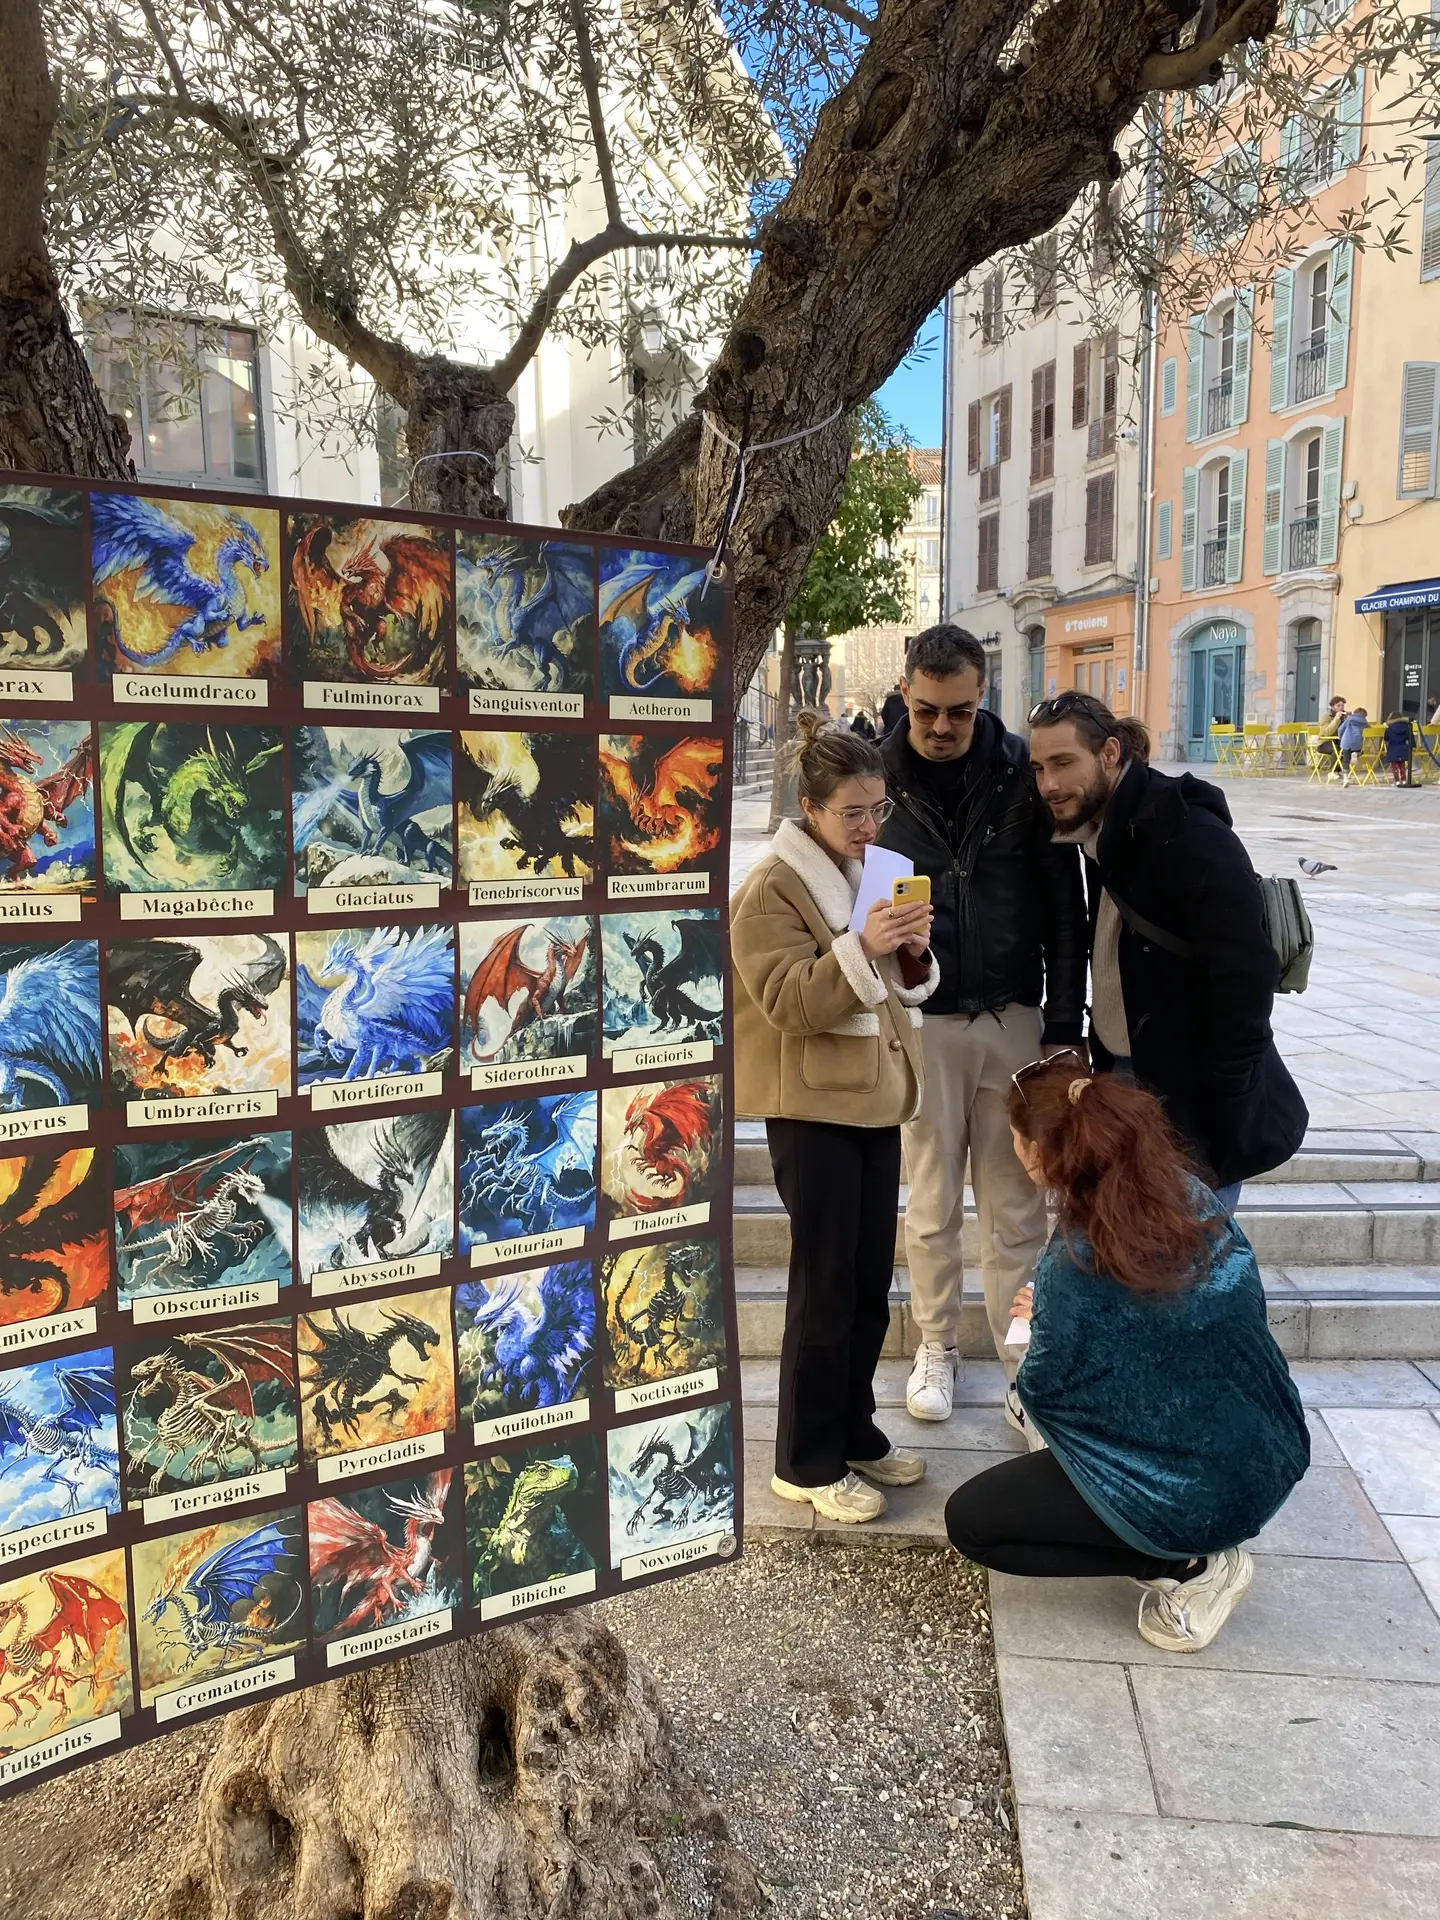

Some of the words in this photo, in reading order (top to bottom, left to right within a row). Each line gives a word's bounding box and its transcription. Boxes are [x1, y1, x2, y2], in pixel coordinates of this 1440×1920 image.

[1361, 599, 1388, 612] GLACIER
[1389, 594, 1427, 607] CHAMPION
[1428, 593, 1439, 603] DU
[1209, 625, 1237, 643] Naya
[125, 680, 257, 700] Caelumdraco
[322, 688, 423, 707] Fulminorax
[472, 694, 581, 713] Sanguisventor
[629, 702, 691, 717] Aetheron
[472, 885, 580, 900] Tenebriscorvus
[612, 879, 705, 894] Rexumbrarum
[143, 897, 254, 916] Magabêche
[335, 891, 414, 907] Glaciatus
[635, 1048, 693, 1065] Glacioris
[484, 1065, 574, 1084] Siderothrax
[332, 1082, 424, 1102] Mortiferon
[144, 1099, 262, 1120] Umbraferris
[632, 1212, 688, 1231] Thalorix
[494, 1237, 563, 1258] Volturian
[338, 1263, 415, 1287] Abyssoth
[153, 1290, 260, 1316] Obscurialis
[630, 1380, 704, 1403] Noctivagus
[491, 1410, 573, 1437] Aquilothan
[338, 1442, 425, 1473] Pyrocladis
[170, 1482, 261, 1512] Terragnis
[0, 1521, 95, 1558] ispectrus
[639, 1542, 707, 1570] Noxvolgus
[512, 1585, 566, 1607] Bibiche
[340, 1620, 440, 1657] Tempestaris
[176, 1669, 276, 1709] Crematoris
[0, 1732, 92, 1779] Fulgurius
